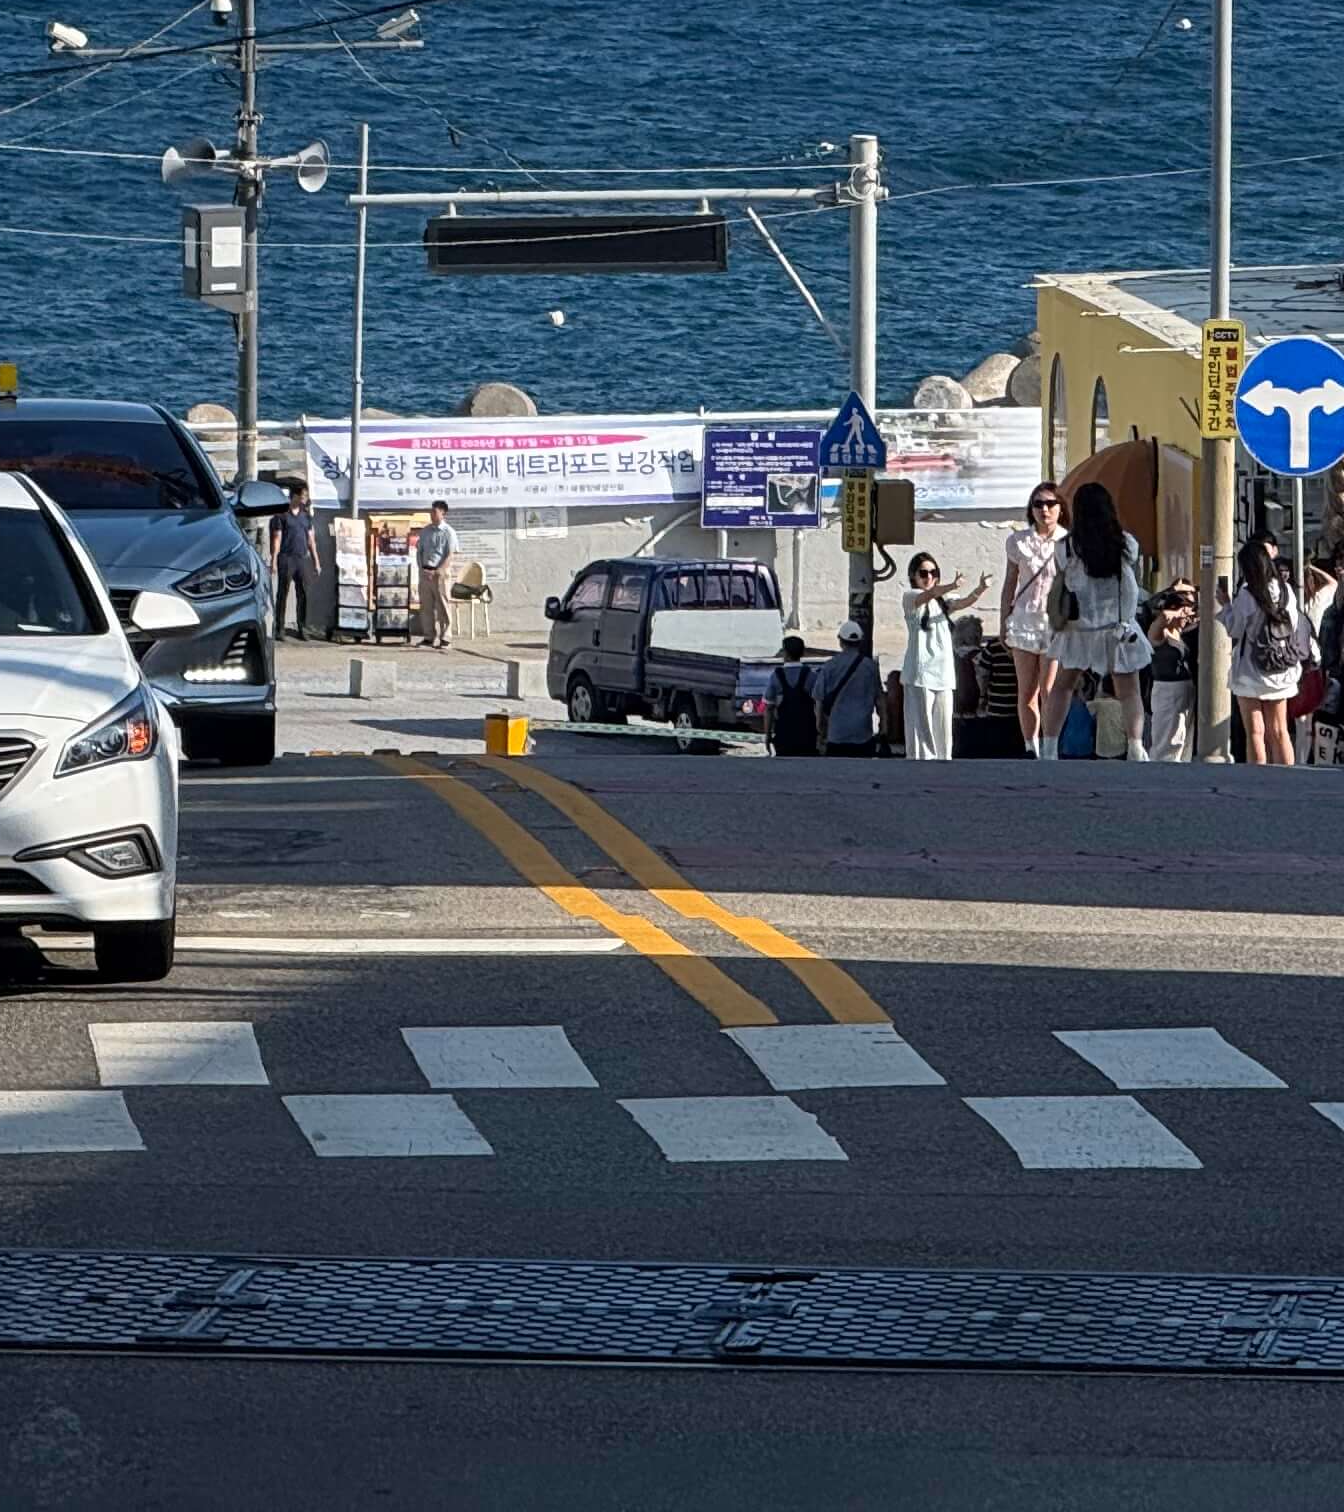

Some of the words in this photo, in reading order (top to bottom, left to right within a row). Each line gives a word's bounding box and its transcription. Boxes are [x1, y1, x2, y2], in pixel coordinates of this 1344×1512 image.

[413, 454, 498, 481] 동방파제
[506, 451, 610, 478] 테트라포드
[616, 448, 695, 476] 보강작업
